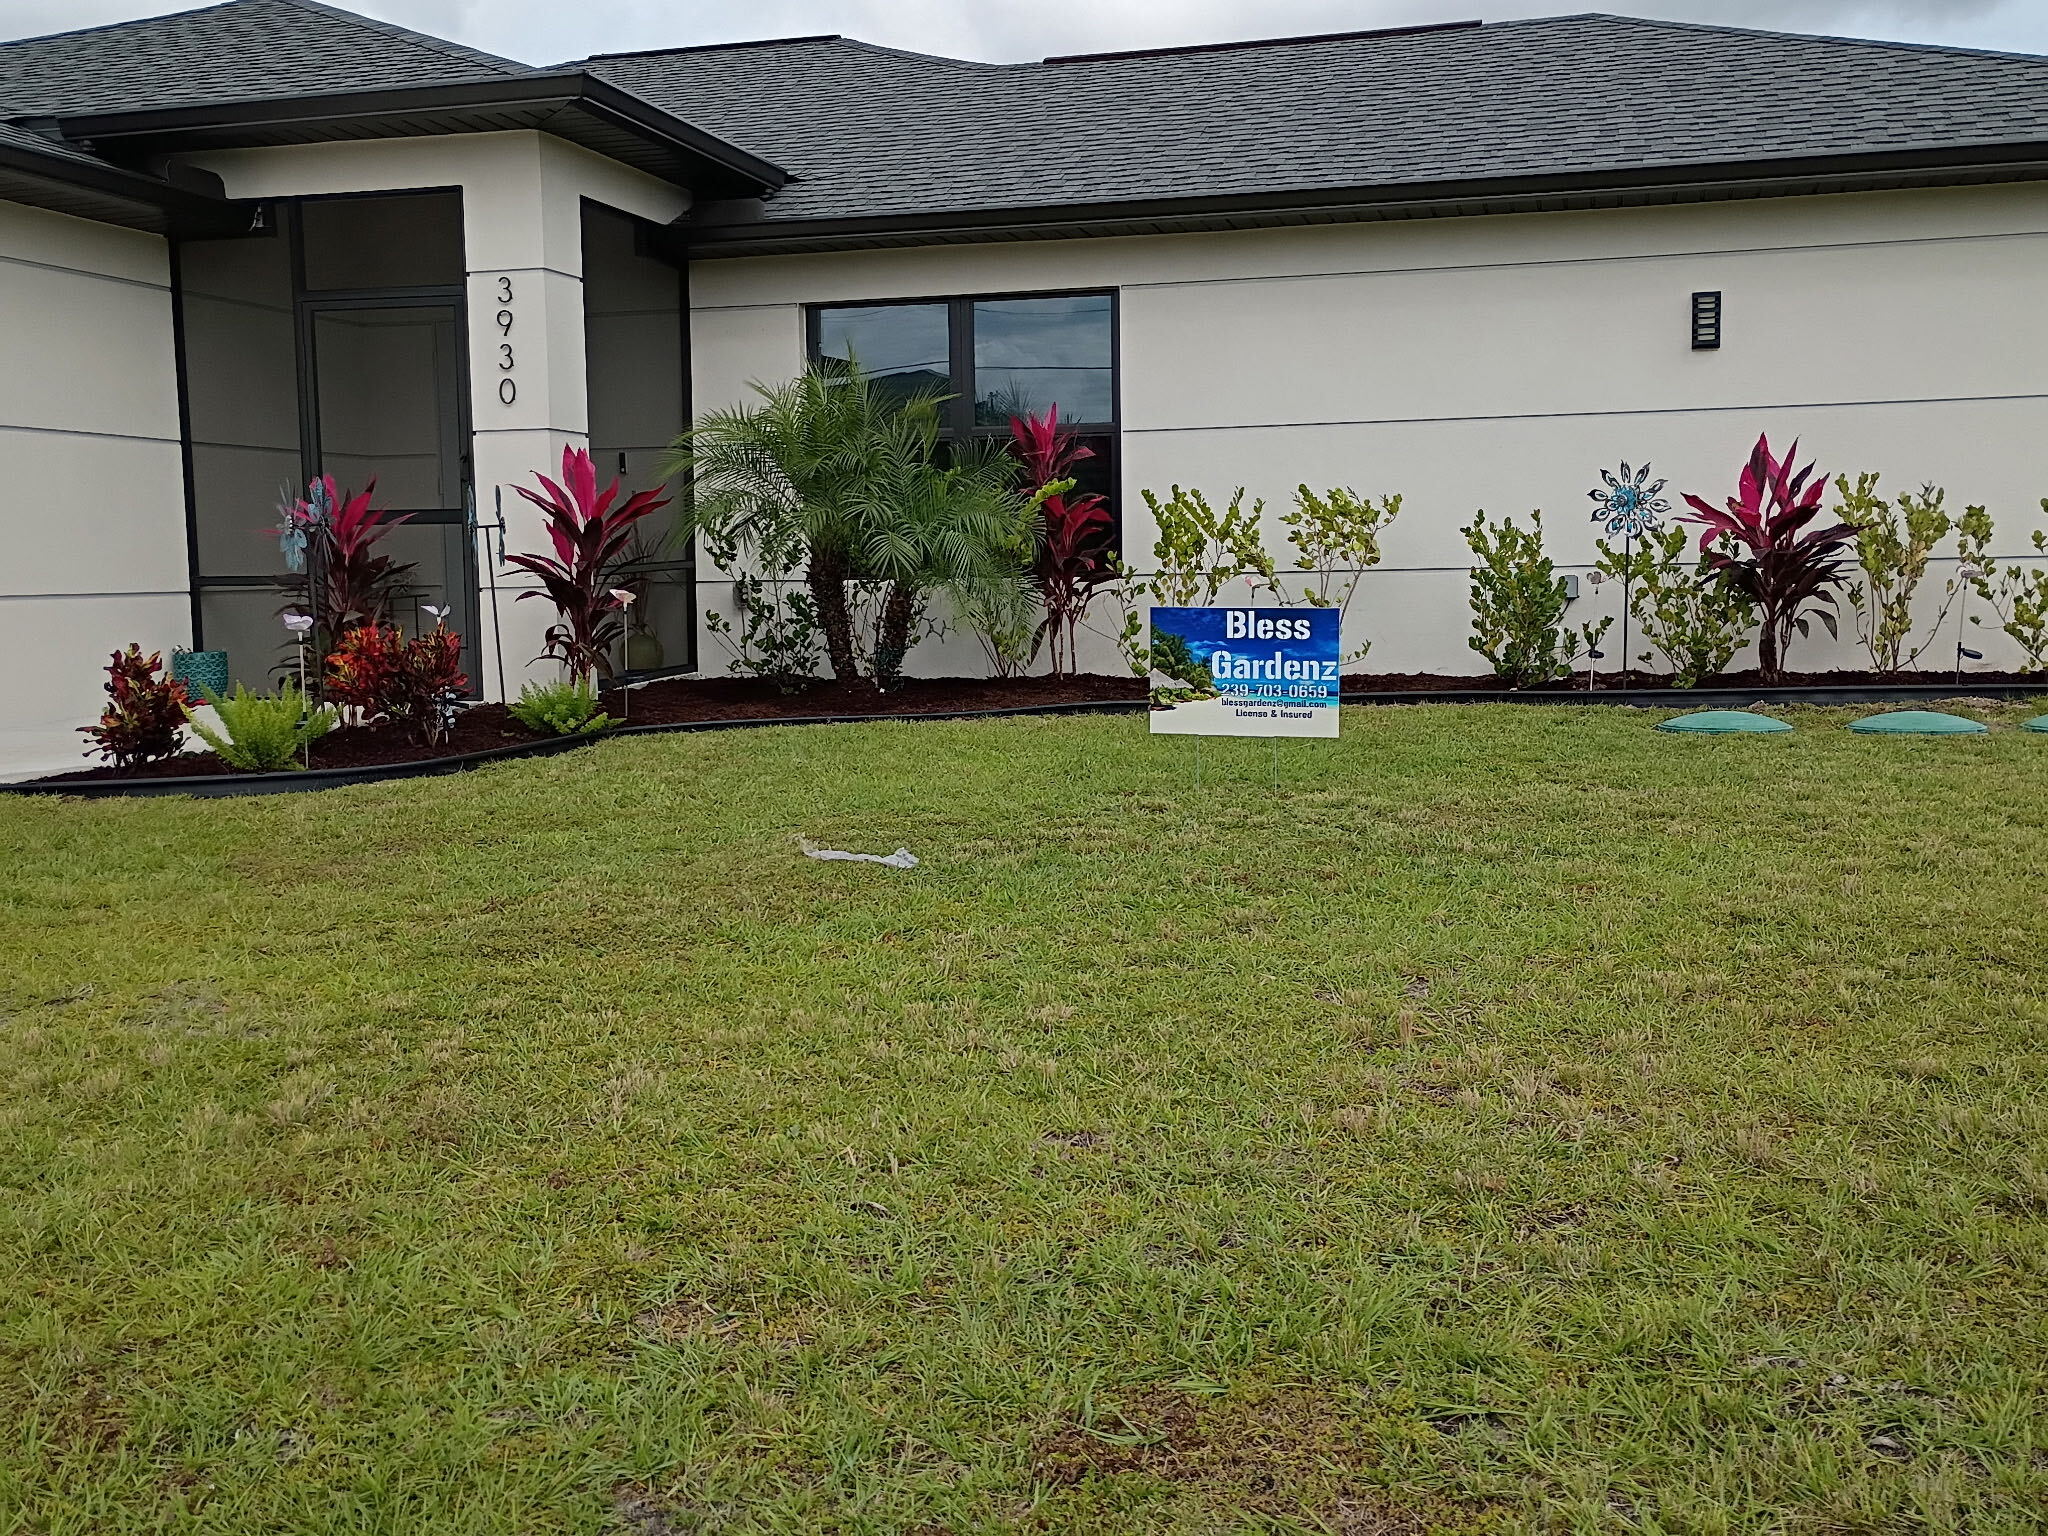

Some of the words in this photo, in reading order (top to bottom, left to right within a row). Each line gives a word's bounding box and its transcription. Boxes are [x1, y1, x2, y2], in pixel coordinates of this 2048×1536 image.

[496, 276, 516, 404] 3930
[1226, 610, 1311, 640] Bless
[1211, 650, 1337, 681] Gardenz
[1221, 683, 1328, 698] 239-703-0659
[1221, 698, 1327, 709] blessgardenz@gmail.com
[1236, 709, 1268, 718] License
[1270, 710, 1278, 718] &
[1280, 710, 1313, 719] Insured
